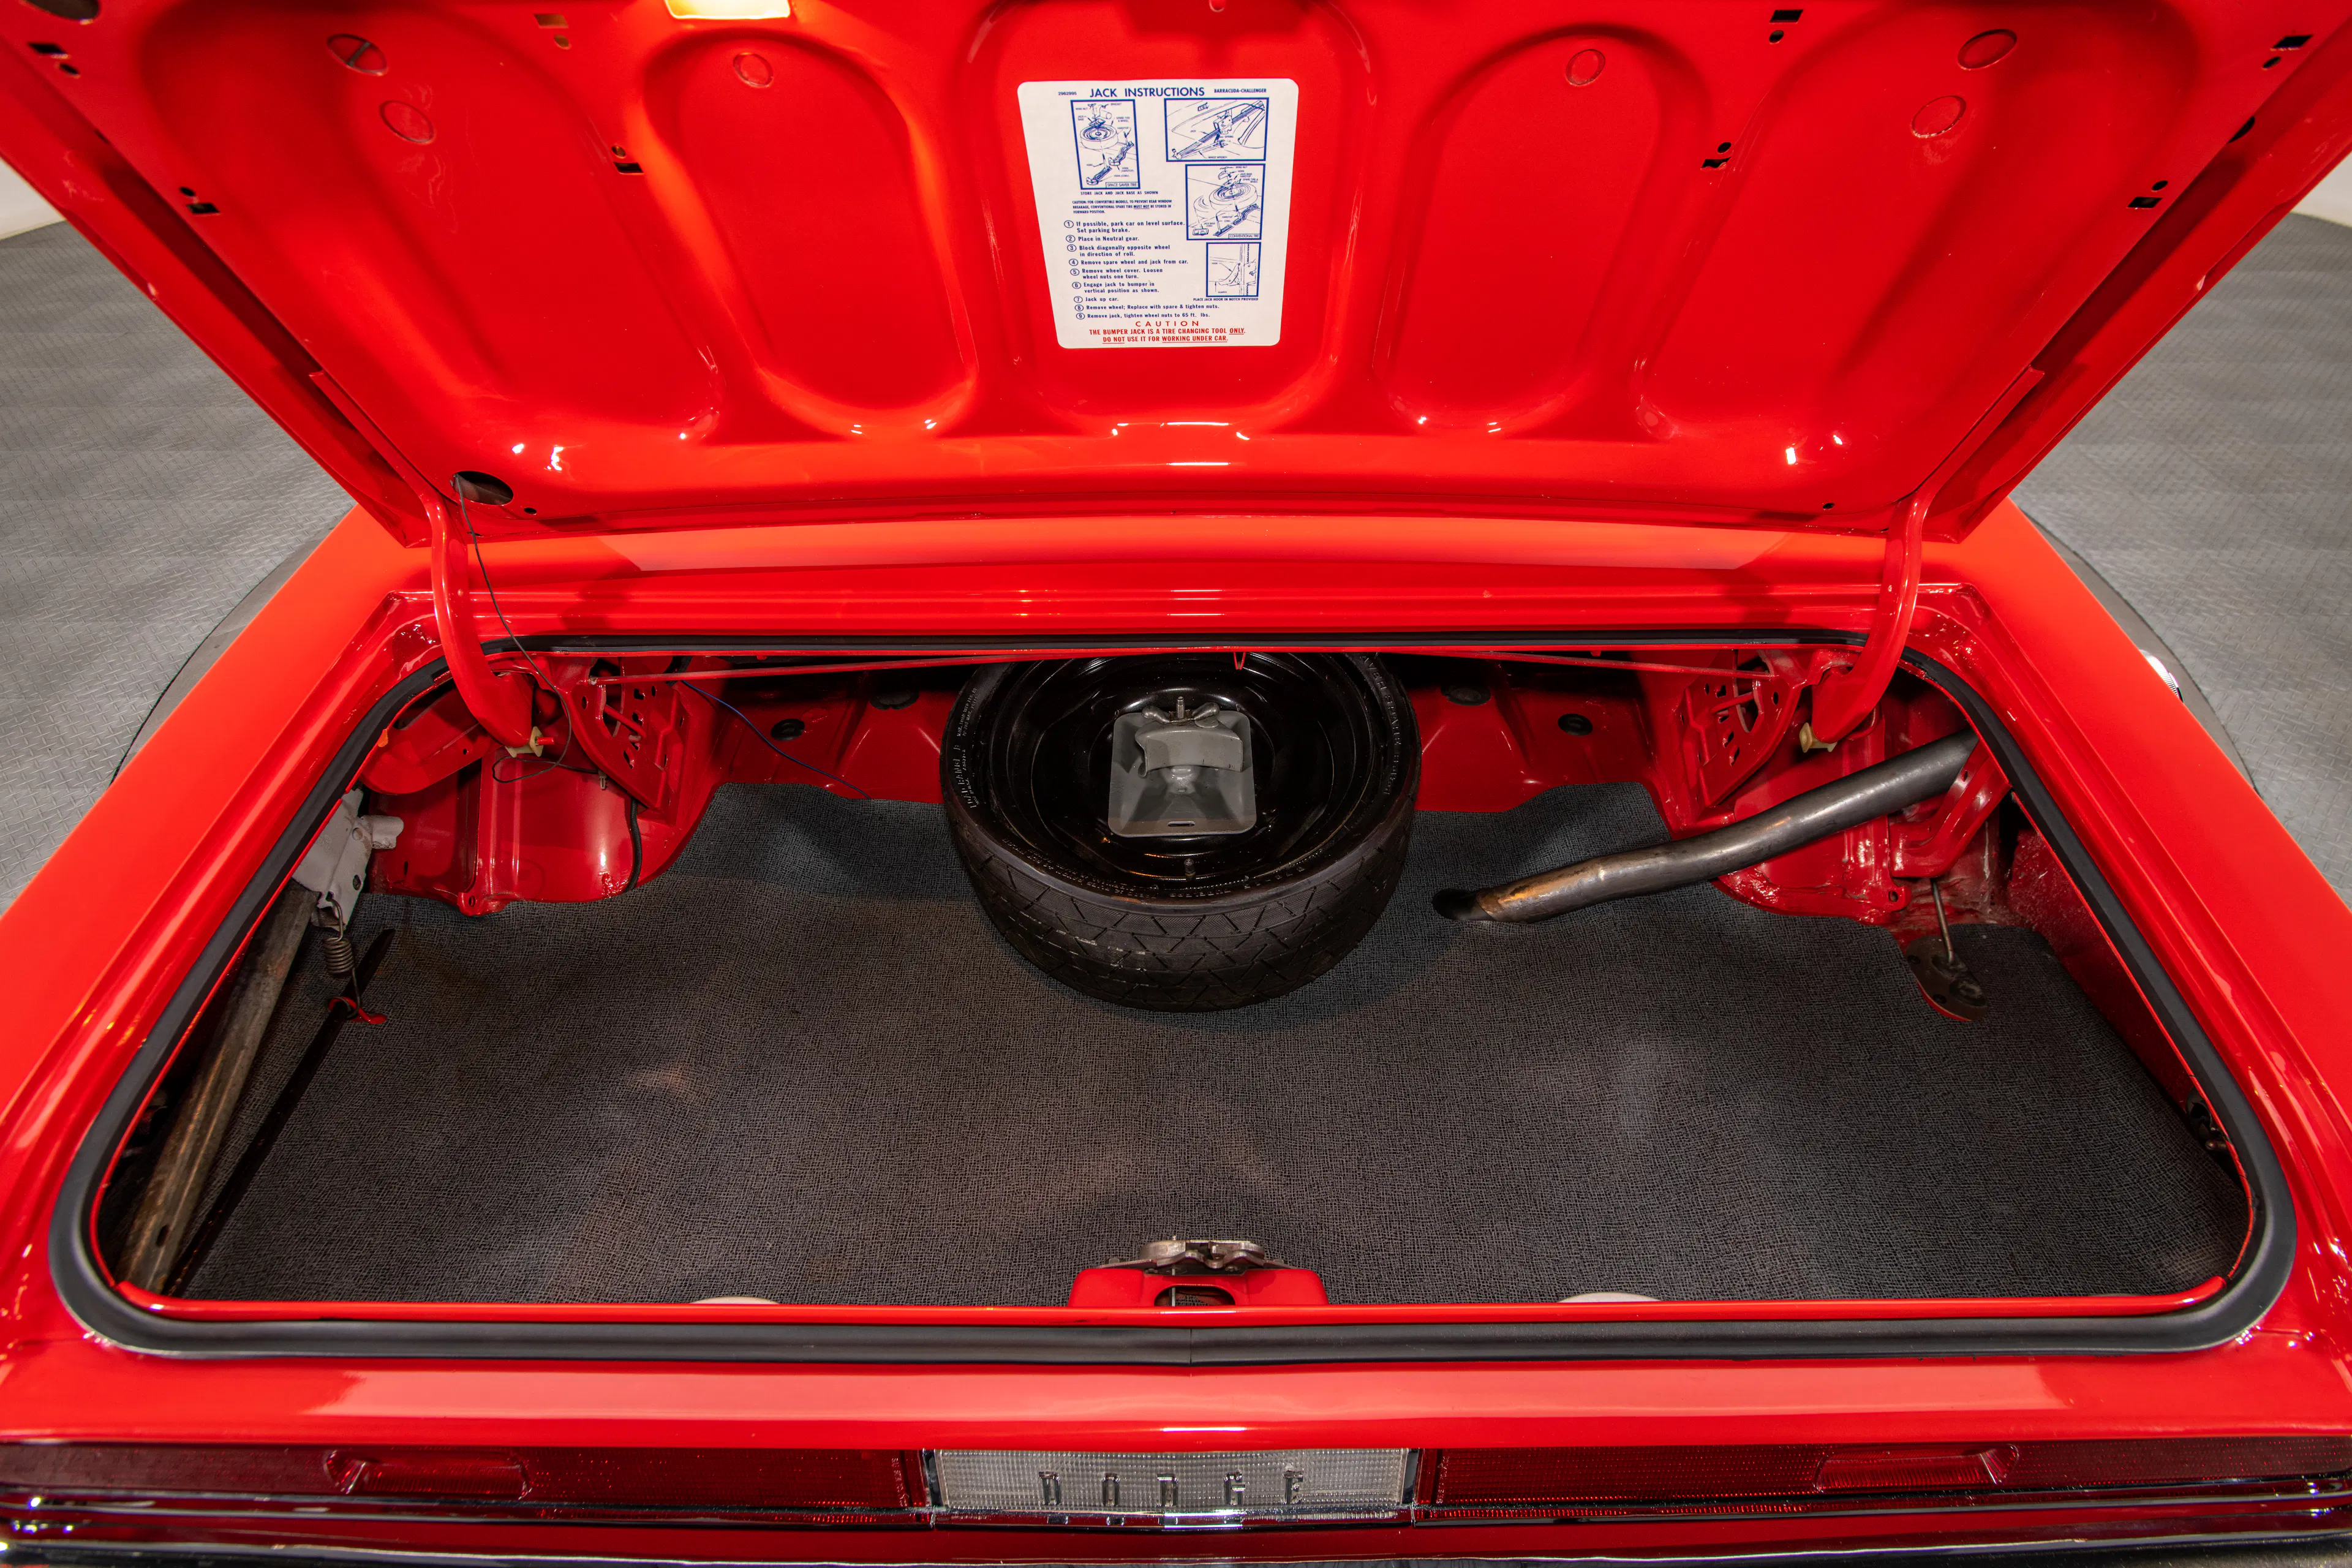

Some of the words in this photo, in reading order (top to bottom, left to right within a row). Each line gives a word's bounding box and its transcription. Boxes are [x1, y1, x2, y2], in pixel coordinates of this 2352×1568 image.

[1090, 89, 1117, 97] JACK
[1125, 87, 1204, 97] INSTRUCTIONS
[1360, 656, 1387, 690] AVER
[1038, 1469, 1305, 1507] DODGE
